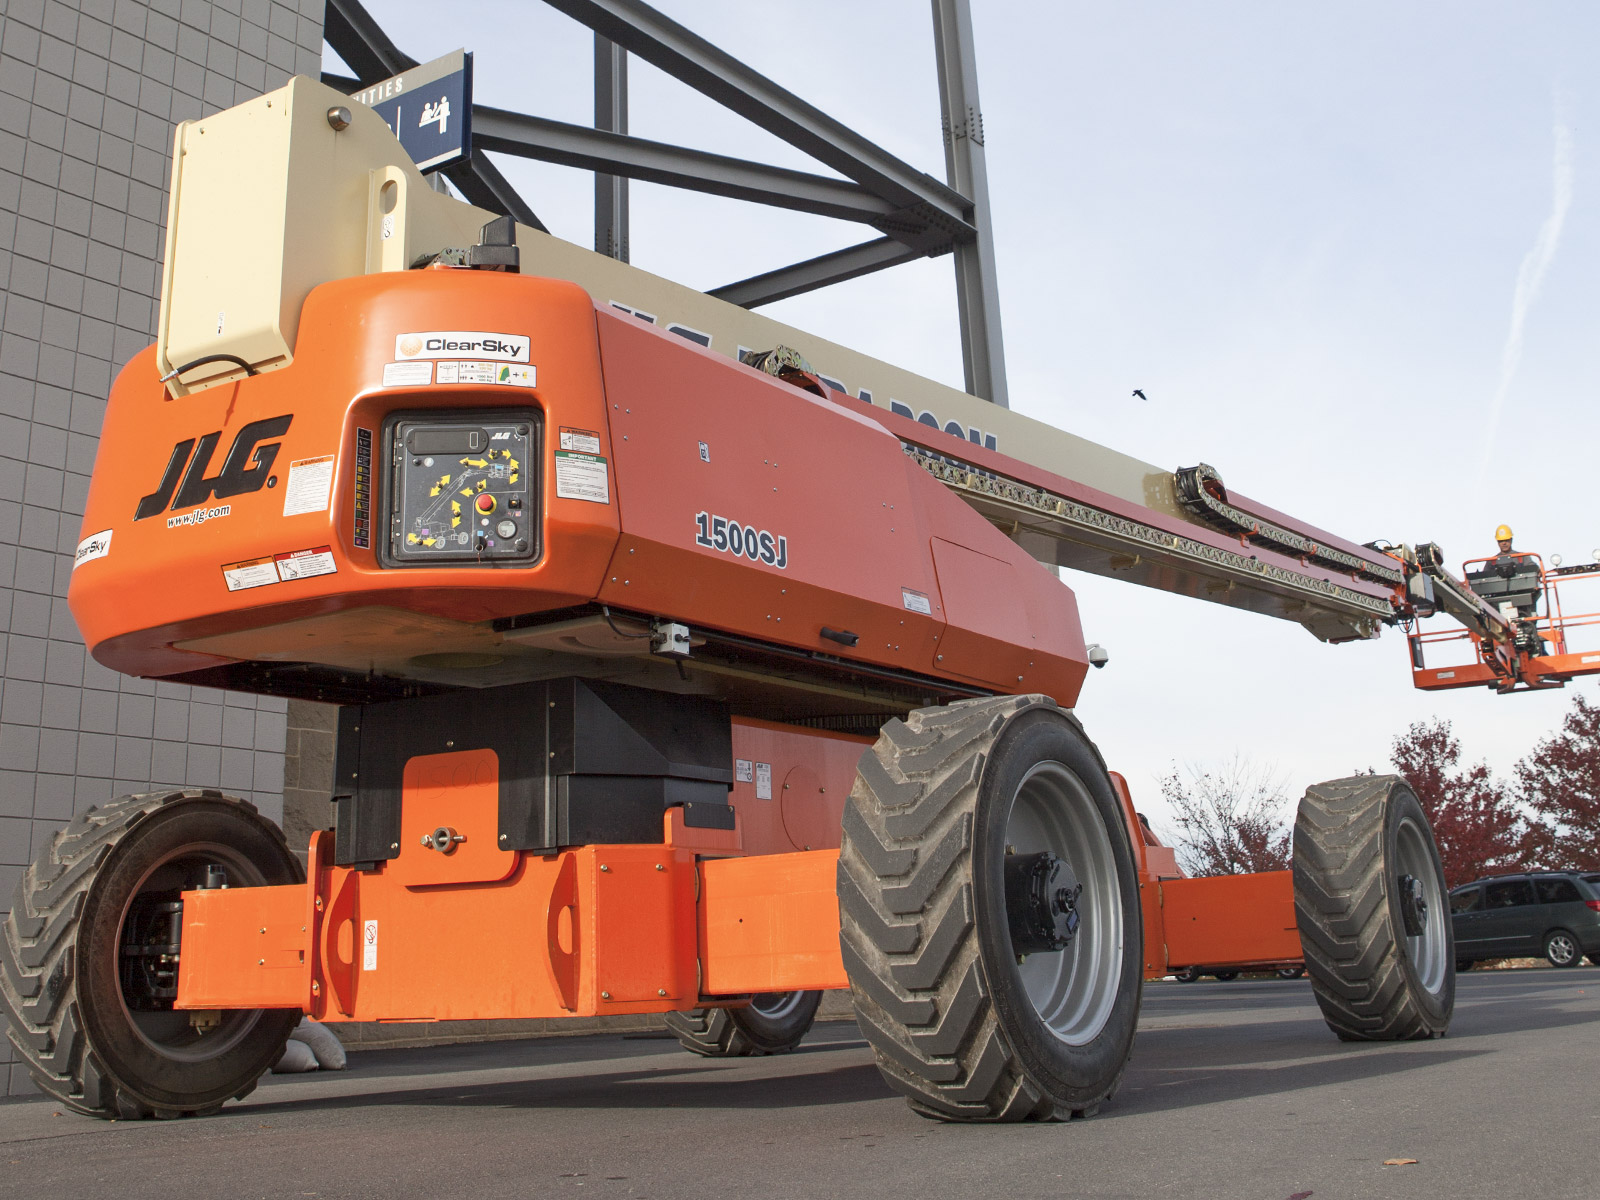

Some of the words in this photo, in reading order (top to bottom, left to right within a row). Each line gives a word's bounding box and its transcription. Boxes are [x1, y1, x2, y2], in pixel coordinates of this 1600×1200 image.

[426, 339, 521, 357] ClearSky
[567, 453, 597, 462] IMPORTANT
[167, 505, 231, 529] www.jlg.com
[696, 511, 787, 569] 1500SJ
